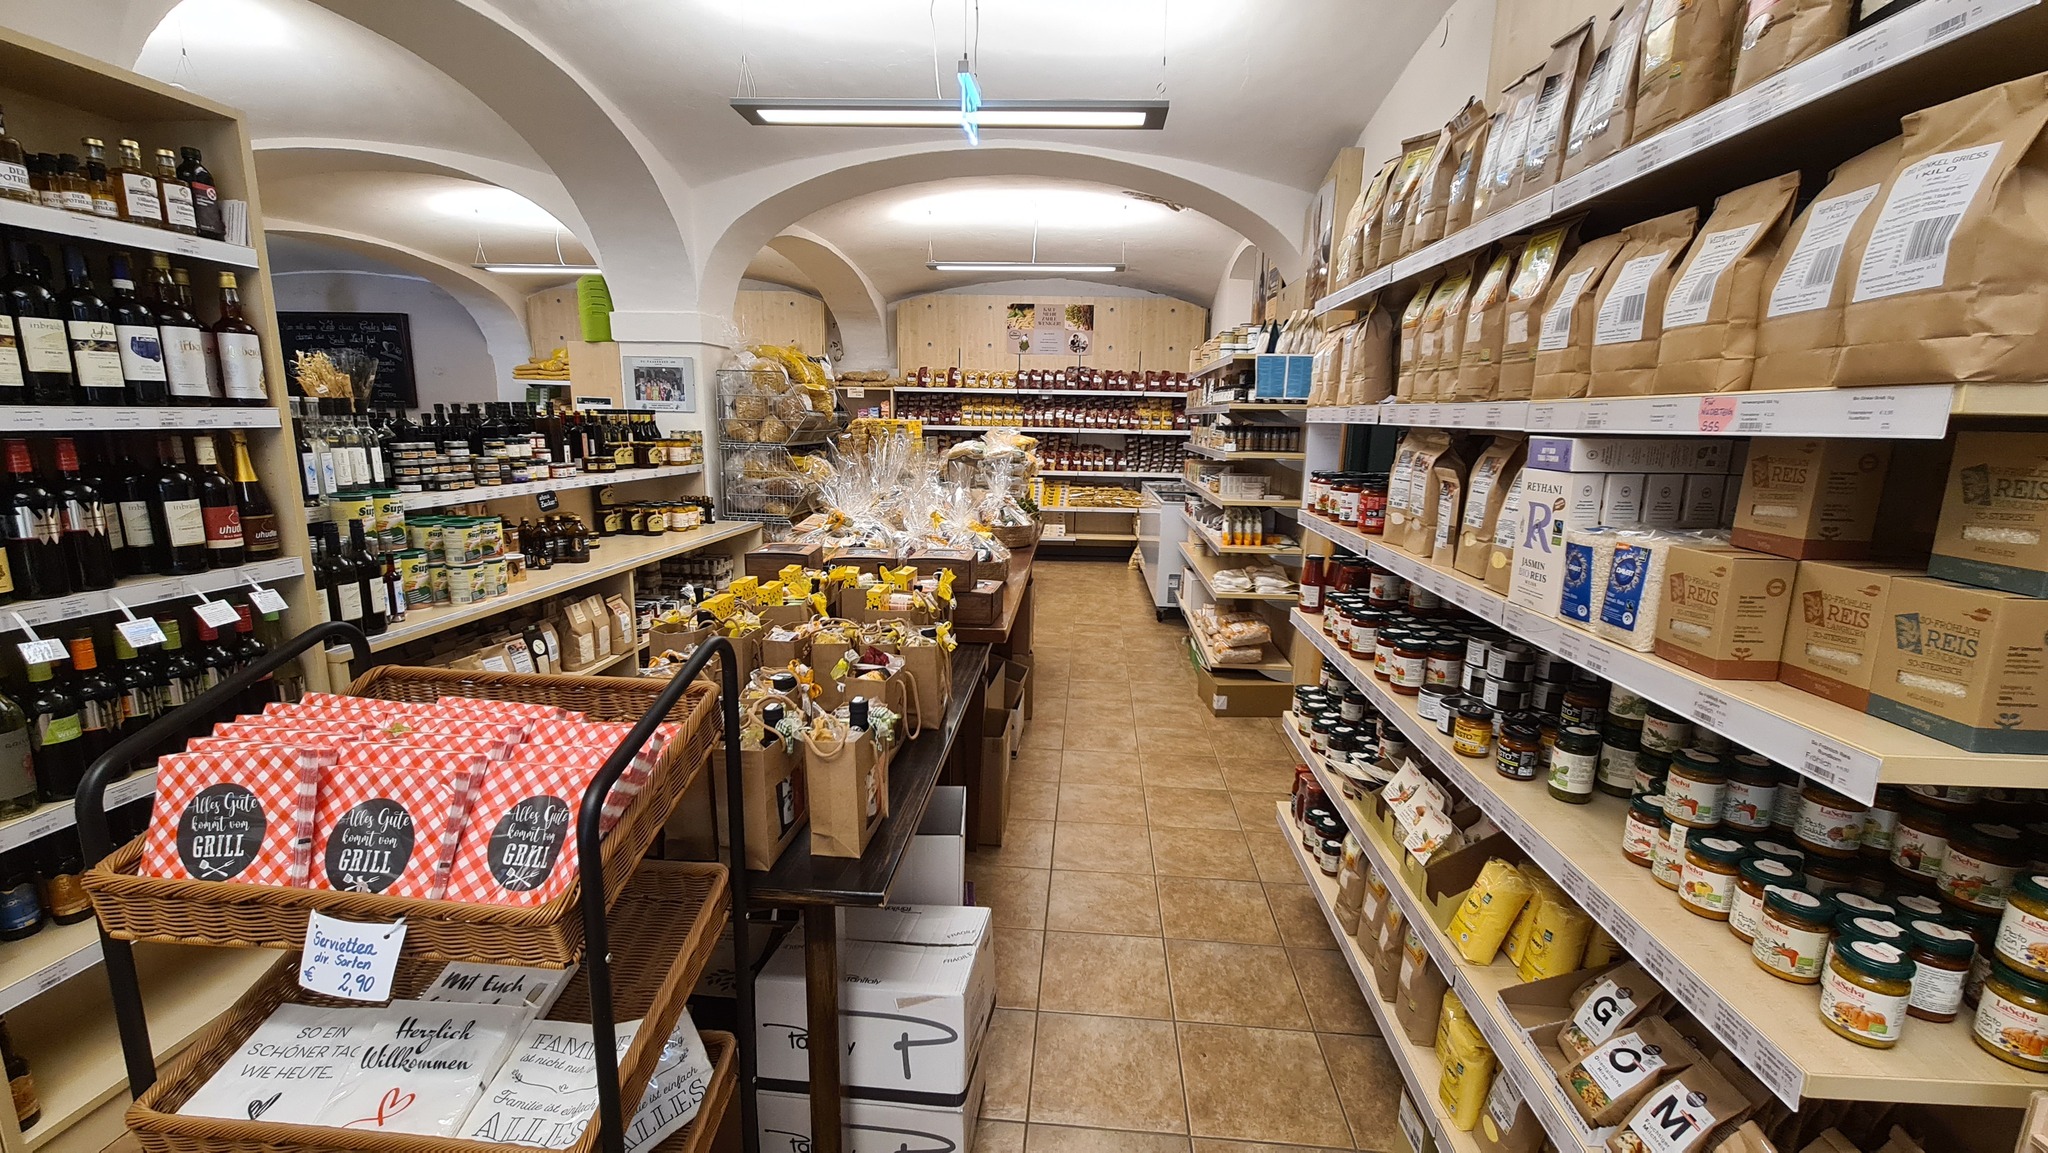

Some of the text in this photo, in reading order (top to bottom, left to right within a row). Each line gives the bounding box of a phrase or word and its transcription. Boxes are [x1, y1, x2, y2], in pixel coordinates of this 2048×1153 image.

[1952, 150, 1990, 165] GRIESS
[1922, 166, 1957, 178] KILO
[1771, 466, 1808, 484] REIS
[1527, 482, 1563, 495] REYHANI
[1521, 557, 1546, 571] JASMIN
[1529, 570, 1547, 583] REIS
[1687, 584, 1719, 606] REIS
[1826, 604, 1871, 629] REIS
[1925, 629, 1979, 658] REIS
[187, 791, 258, 818] Alles Gute
[506, 804, 540, 825] Alles
[191, 816, 250, 832] kommt vom
[340, 807, 411, 833] Alles Gute
[341, 827, 398, 848] kommt vom
[506, 823, 547, 843] kommt
[192, 833, 245, 858] GRILL
[502, 842, 550, 869] GRILL
[338, 848, 392, 874] GRILL
[1761, 915, 1789, 936] LaSelva
[313, 931, 378, 956] Servietten
[334, 953, 372, 971] Sorten
[943, 951, 973, 965] FRAGILE
[303, 966, 375, 997] € 2,90
[1831, 974, 1866, 999] LaSelva
[1996, 999, 2039, 1024] LaSelva
[296, 1026, 353, 1039] SO EIN
[395, 1015, 477, 1055] Herzlich
[247, 1042, 331, 1059] SCHÖNER
[360, 1043, 473, 1073] Willkommen
[240, 1063, 277, 1079] WIE
[520, 1053, 537, 1064] ist
[537, 1055, 565, 1070] nicht
[662, 1066, 699, 1093] einfach
[493, 1089, 597, 1122] Familie ist einfach
